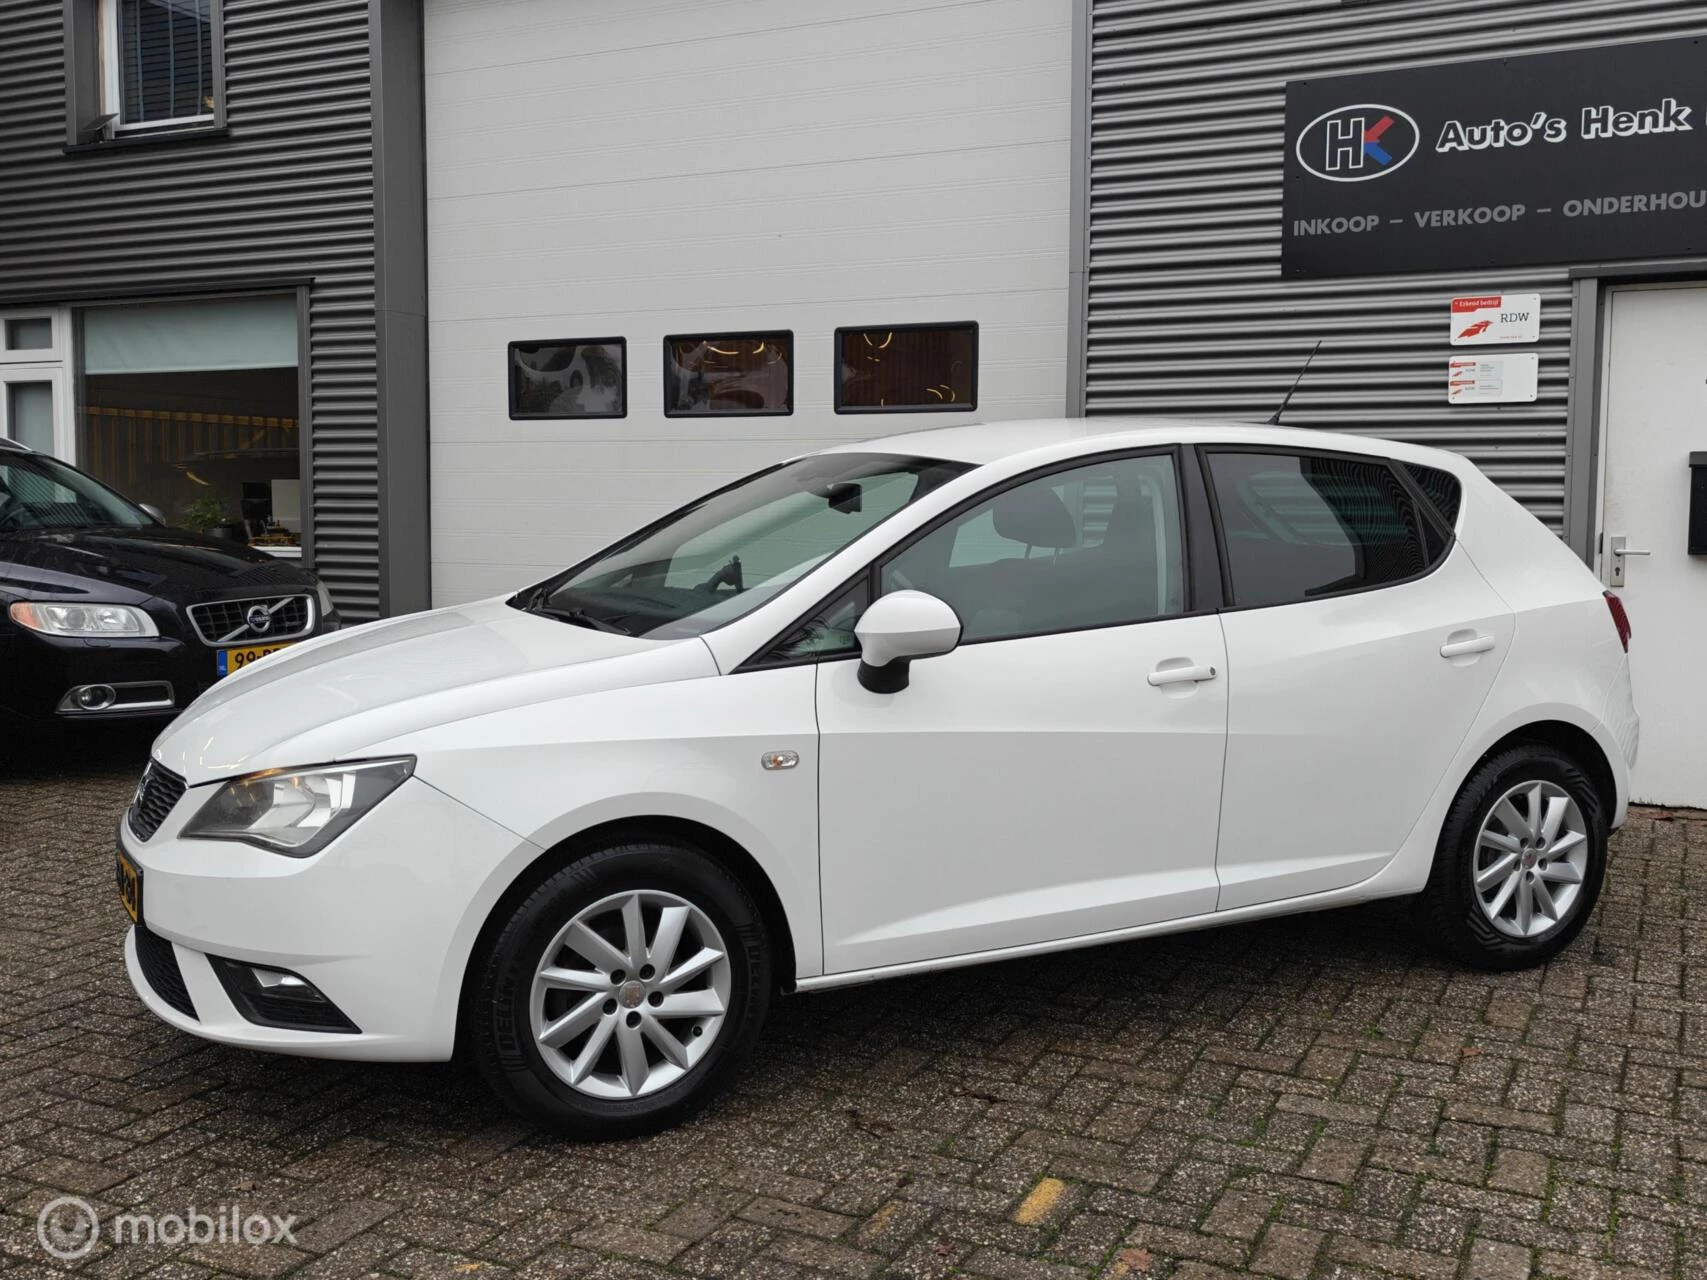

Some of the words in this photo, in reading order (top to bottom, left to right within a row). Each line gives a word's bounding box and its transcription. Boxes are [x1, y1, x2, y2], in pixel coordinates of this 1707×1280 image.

[1435, 111, 1567, 153] Auto's
[1581, 97, 1694, 140] Henk
[1293, 214, 1380, 237] INKOOP
[1413, 203, 1526, 229] VERKOOP
[1500, 311, 1530, 324] RDW
